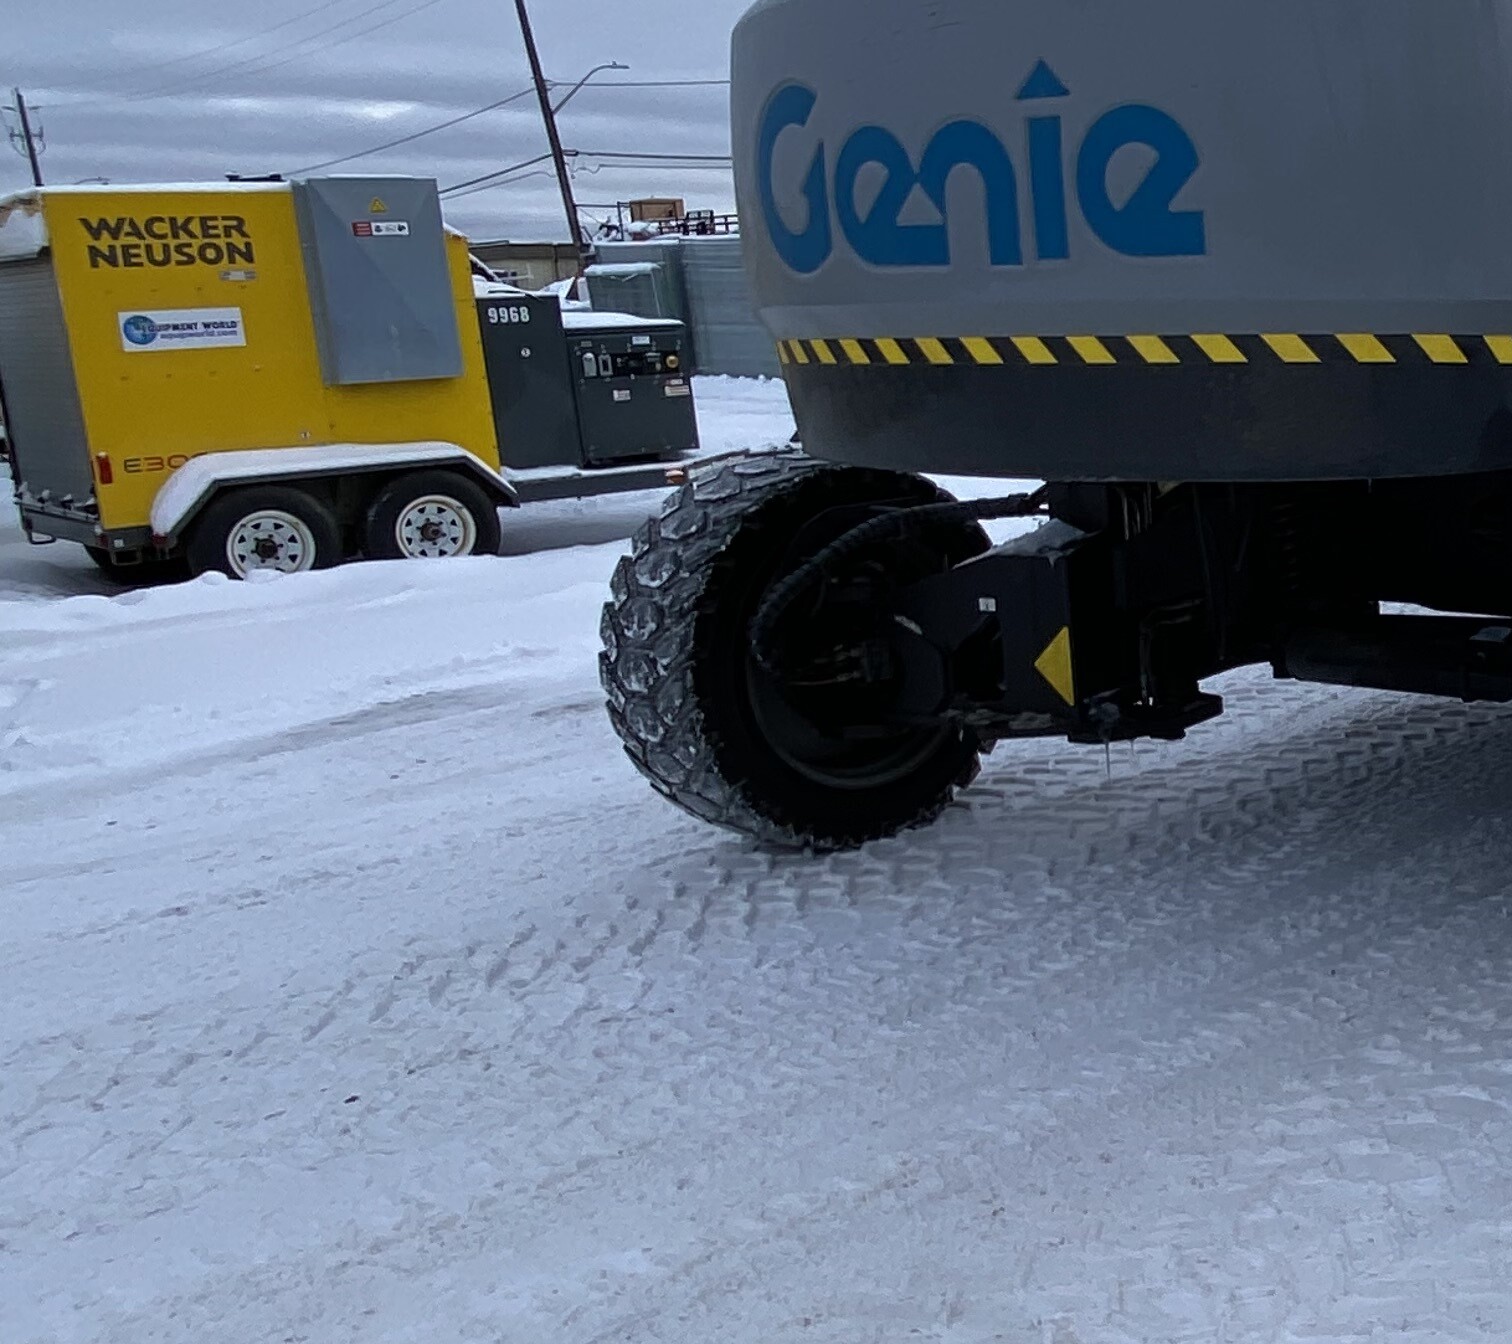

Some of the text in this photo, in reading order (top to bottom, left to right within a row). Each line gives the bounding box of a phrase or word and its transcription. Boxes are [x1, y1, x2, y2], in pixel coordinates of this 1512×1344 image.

[755, 58, 1207, 275] Genie
[77, 215, 251, 241] WACKER
[87, 240, 255, 268] NEUSON
[202, 320, 238, 329] WORLD
[487, 306, 530, 324] 9968
